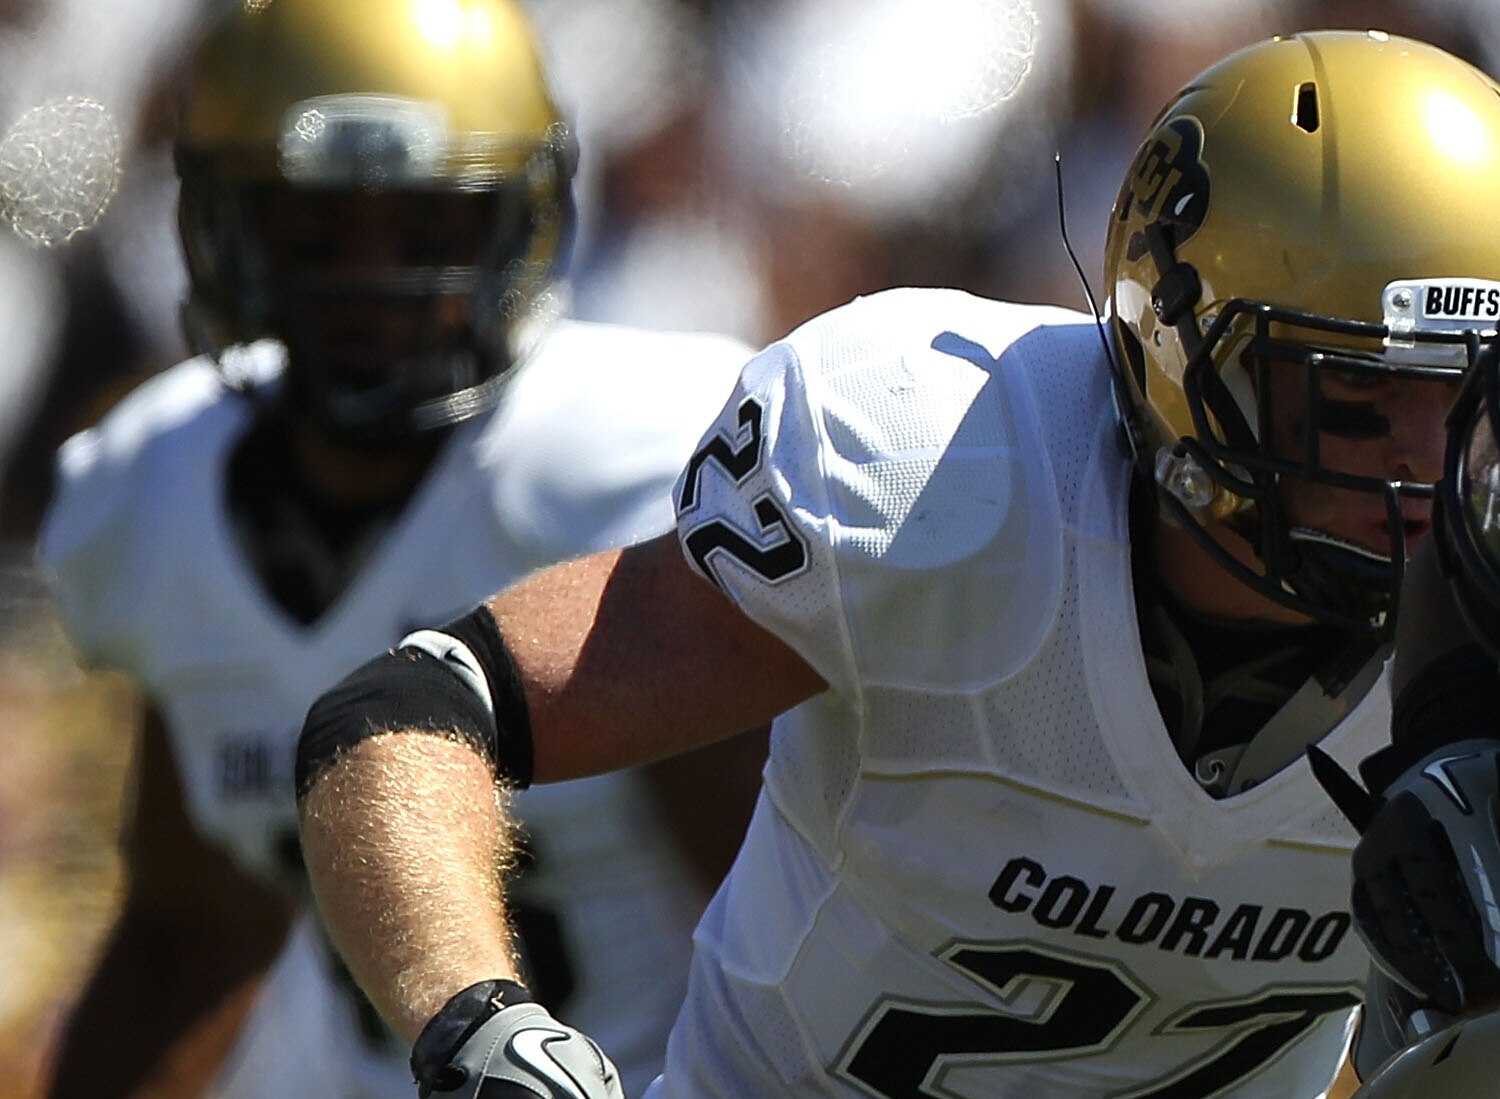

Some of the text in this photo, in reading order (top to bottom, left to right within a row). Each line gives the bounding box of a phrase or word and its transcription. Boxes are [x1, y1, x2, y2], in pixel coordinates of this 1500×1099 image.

[1424, 286, 1500, 317] BUFFS
[677, 393, 813, 590] 22
[987, 856, 1352, 964] COLORADO
